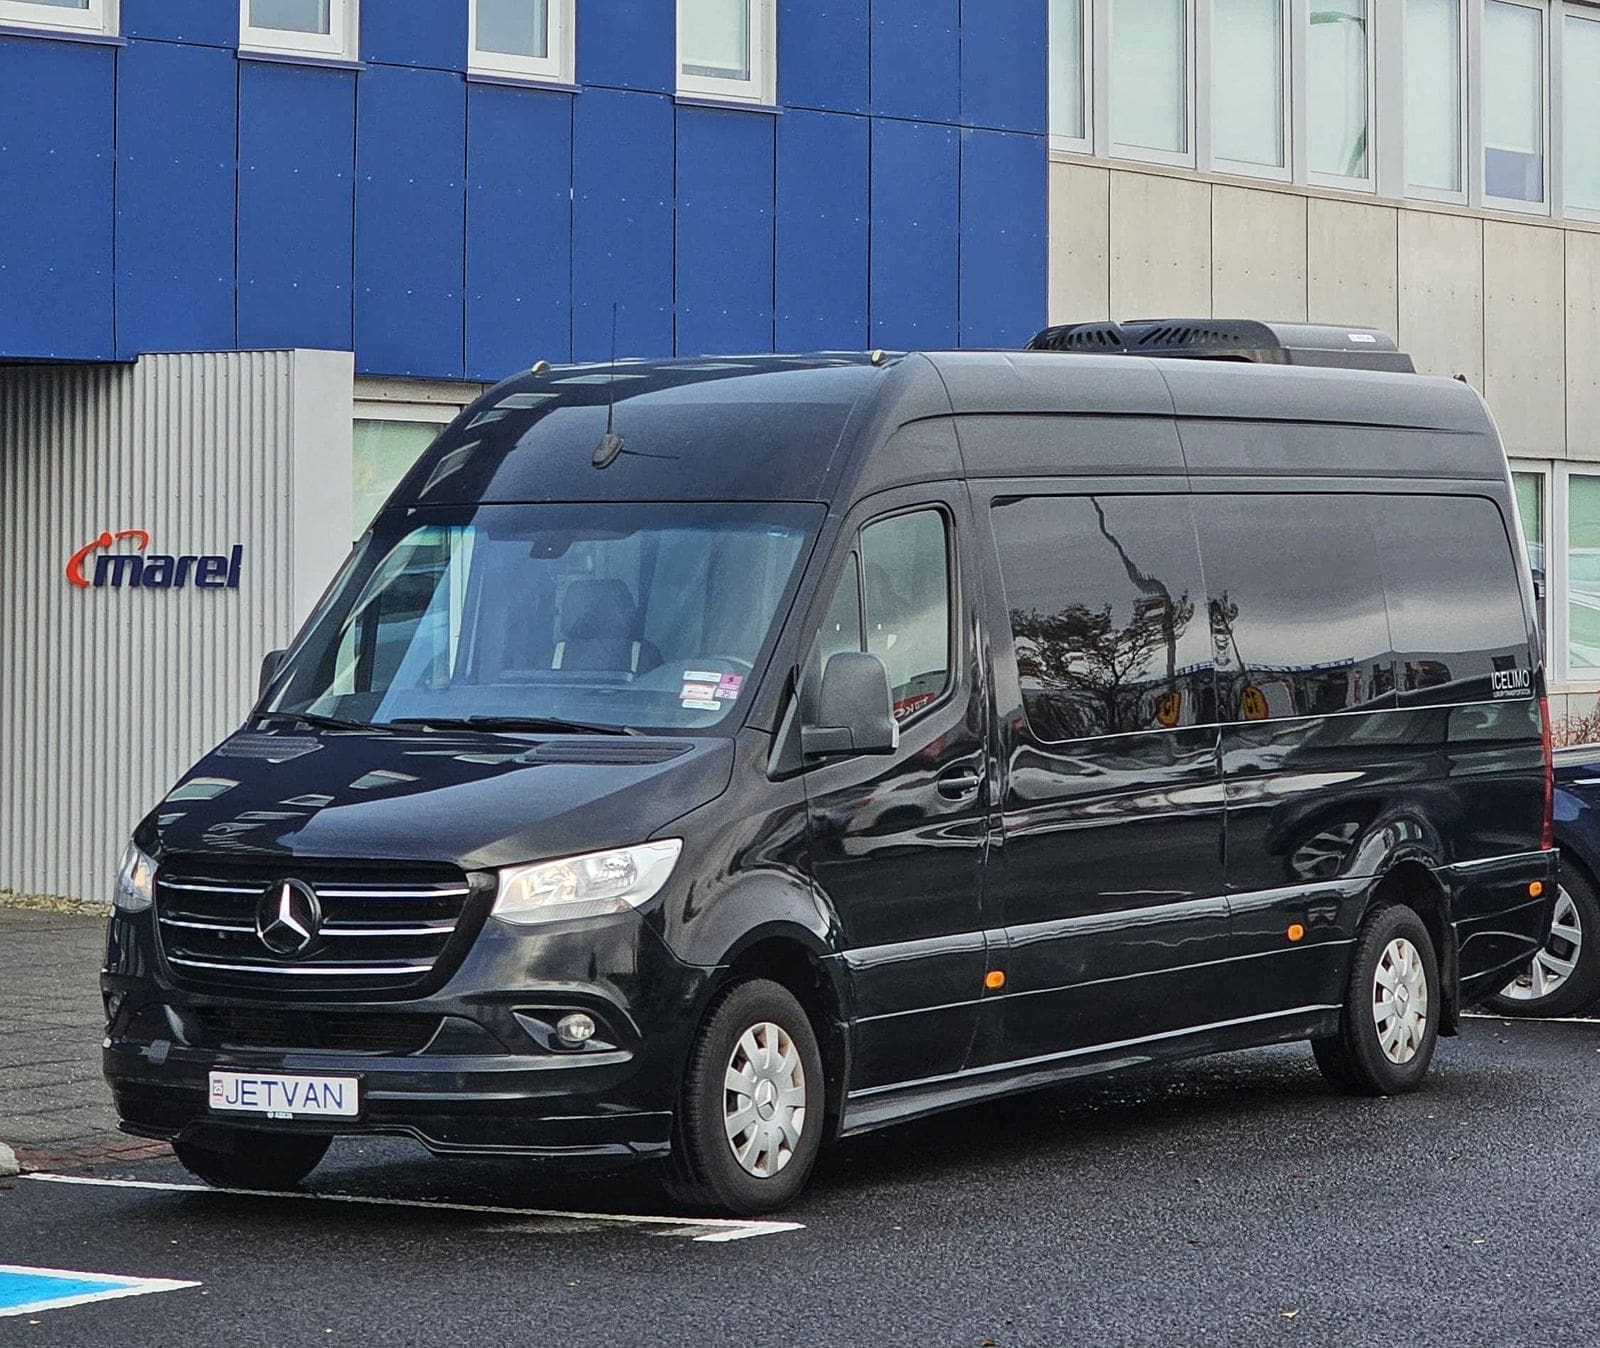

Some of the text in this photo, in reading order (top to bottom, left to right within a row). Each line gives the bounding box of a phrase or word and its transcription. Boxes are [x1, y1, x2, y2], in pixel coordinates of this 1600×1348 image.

[93, 544, 243, 588] marel
[1490, 669, 1530, 690] ICELIMO
[226, 1078, 343, 1109] JETVAN
